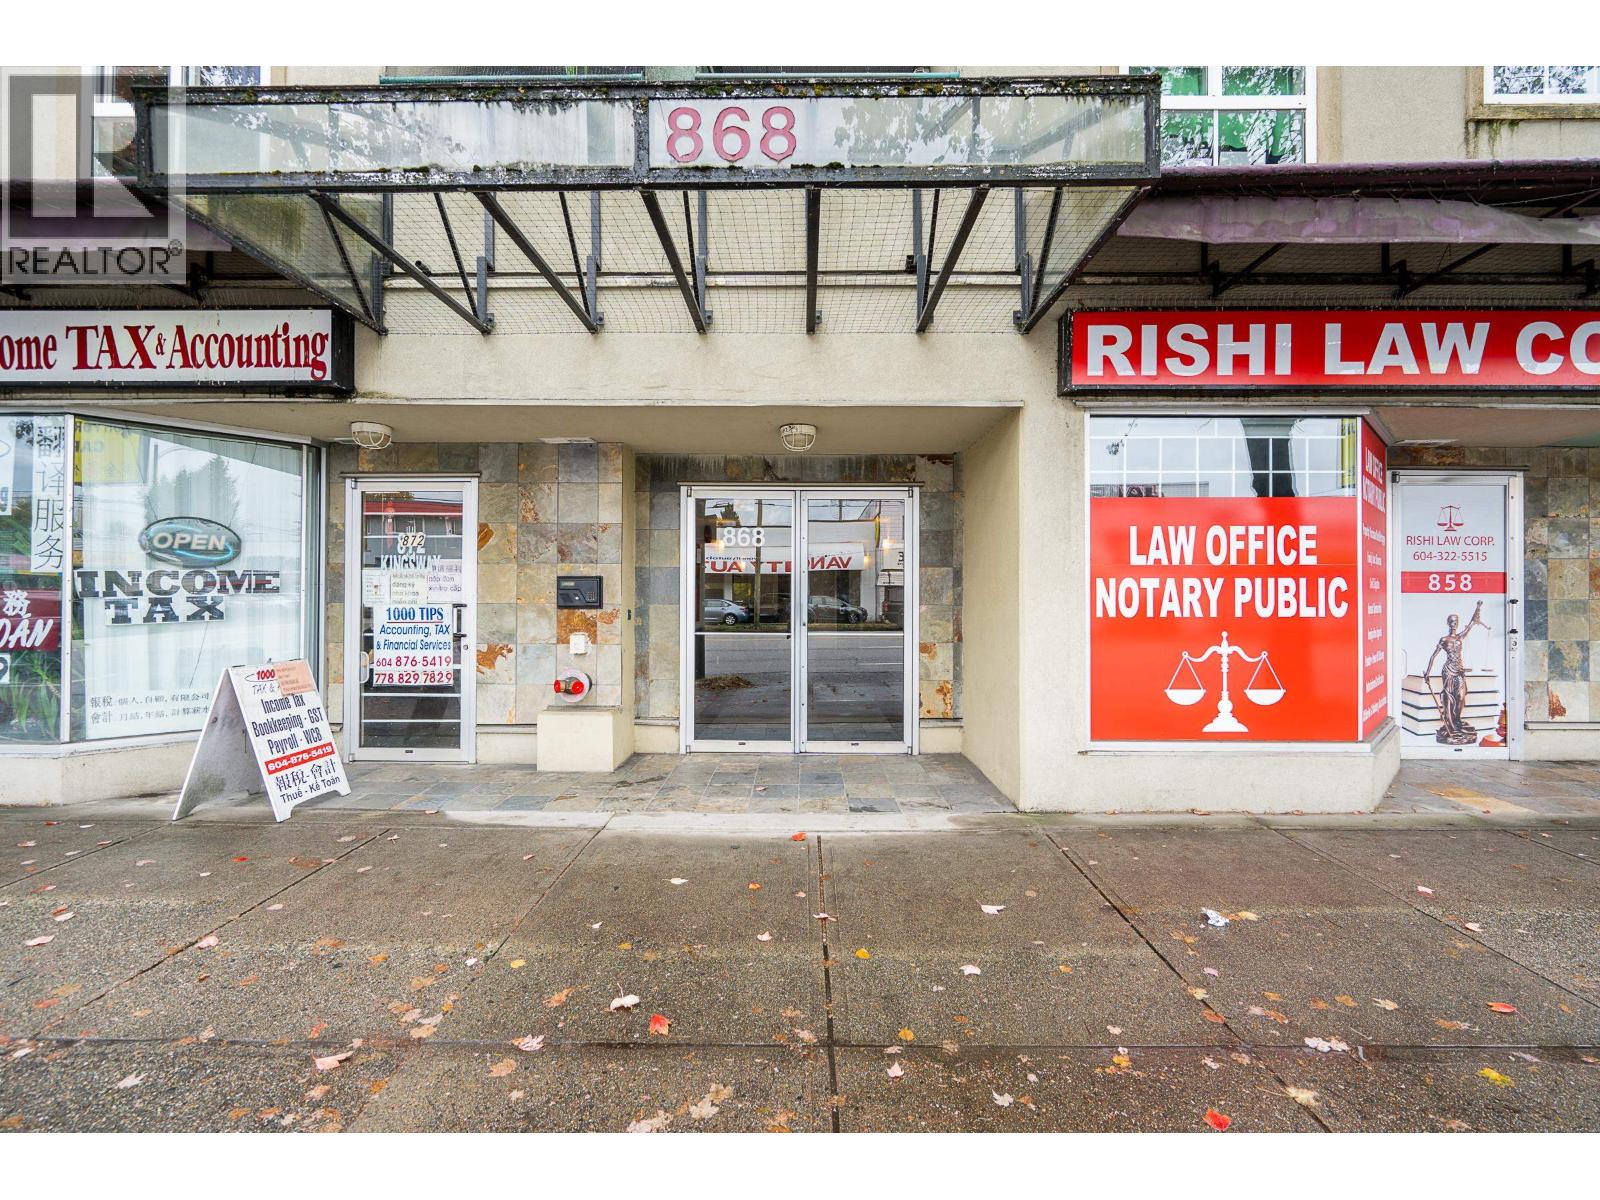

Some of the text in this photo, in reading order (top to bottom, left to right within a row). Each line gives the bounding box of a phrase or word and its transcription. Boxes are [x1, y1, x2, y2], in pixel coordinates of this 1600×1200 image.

[667, 106, 797, 163] 868
[66, 325, 156, 370] TAX
[156, 332, 166, 356] &
[166, 322, 329, 381] Accounting
[1087, 323, 1291, 376] RISHI
[1324, 322, 1490, 375] LAW
[153, 532, 226, 551] OPEN
[402, 535, 425, 546] 872
[723, 527, 765, 547] 868
[1130, 525, 1196, 566] LAW
[1205, 524, 1318, 566] OFFICE
[1406, 535, 1495, 546] RISHI LAW CORP.
[380, 554, 442, 570] KINGSWAY
[1413, 552, 1488, 561] 604-322-5515
[77, 570, 280, 598] INCOME
[1428, 574, 1473, 591] 858
[1096, 577, 1349, 618] NOTARY PUBLIC
[105, 596, 225, 624] TAX
[386, 607, 444, 621] 1000 TIPS
[379, 624, 451, 637] Accounting, TAX
[376, 639, 452, 650] & Financial Services
[376, 656, 452, 667] 604 876-5419
[256, 669, 276, 681] 1000
[375, 672, 453, 684] 778 829 7829
[261, 694, 306, 714] Income Tax
[252, 707, 324, 737] Bookkeeping GST
[267, 727, 323, 756] Payroll WCB
[268, 745, 333, 771] 604-876-5419
